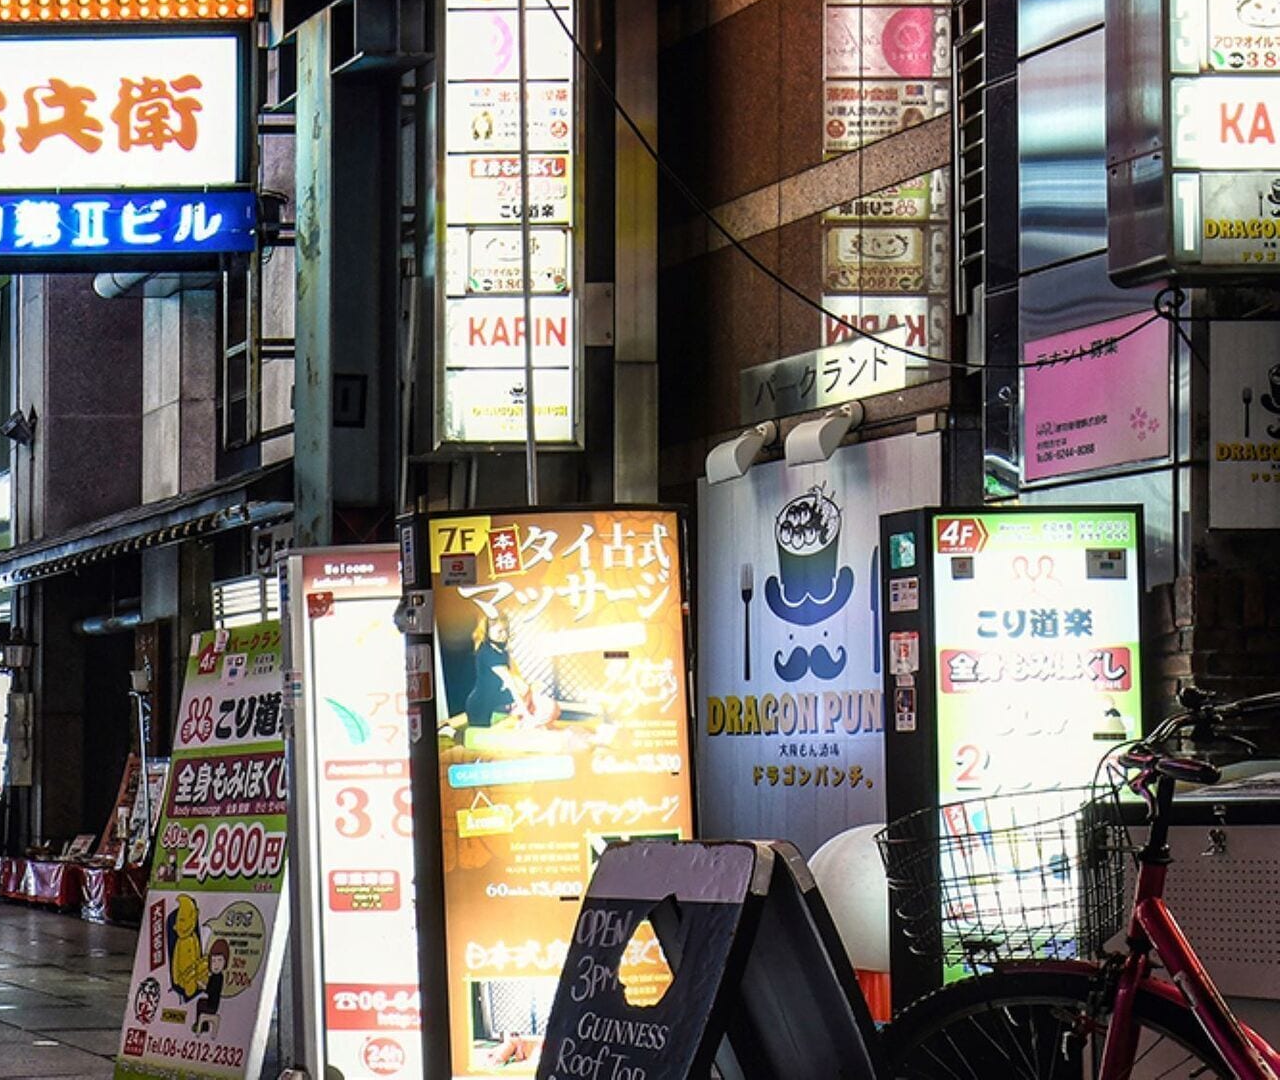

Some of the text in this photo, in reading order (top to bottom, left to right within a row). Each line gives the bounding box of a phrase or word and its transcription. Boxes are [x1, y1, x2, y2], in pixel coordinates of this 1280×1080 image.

[754, 347, 889, 406] パークランド
[439, 527, 475, 554] 7F
[493, 532, 518, 570] 本格
[520, 524, 672, 572] タイ古式
[940, 521, 974, 545] 4F
[457, 569, 673, 624] マッサージ
[976, 609, 1094, 639] こり道楽
[215, 692, 289, 740] こり道
[706, 692, 819, 736] DRAGON
[174, 759, 289, 804] 全身もみほぐし
[183, 822, 283, 877] 2,800円
[576, 908, 634, 949] OPEN
[577, 1011, 671, 1051] GUINNESS
[556, 1037, 611, 1077] Roof
